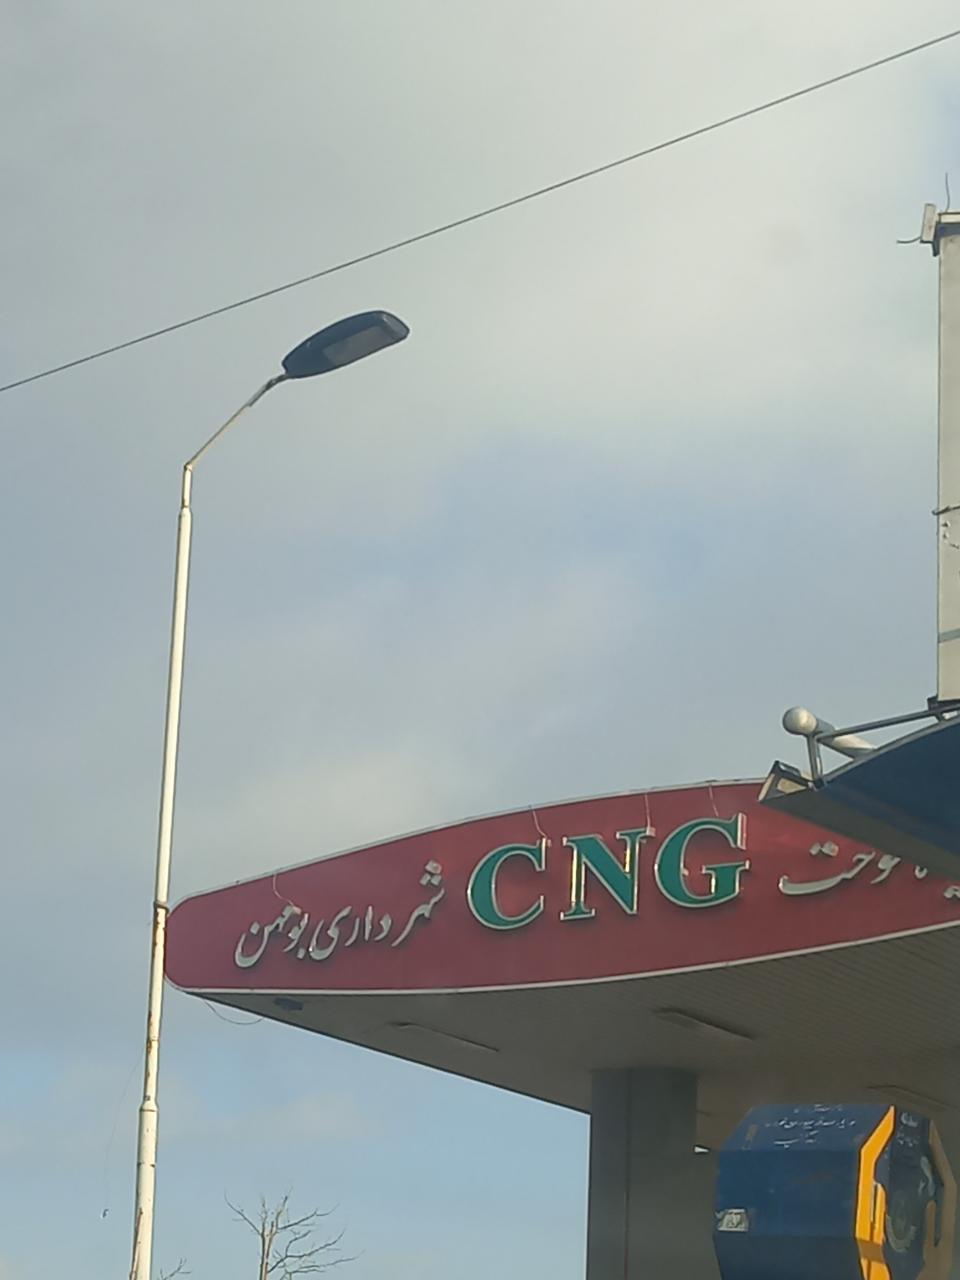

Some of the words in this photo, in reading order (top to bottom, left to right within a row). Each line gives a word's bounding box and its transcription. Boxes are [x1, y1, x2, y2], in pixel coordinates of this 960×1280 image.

[308, 859, 445, 961] شهرداری
[466, 812, 749, 930] CNG
[234, 904, 309, 968] بومهن
